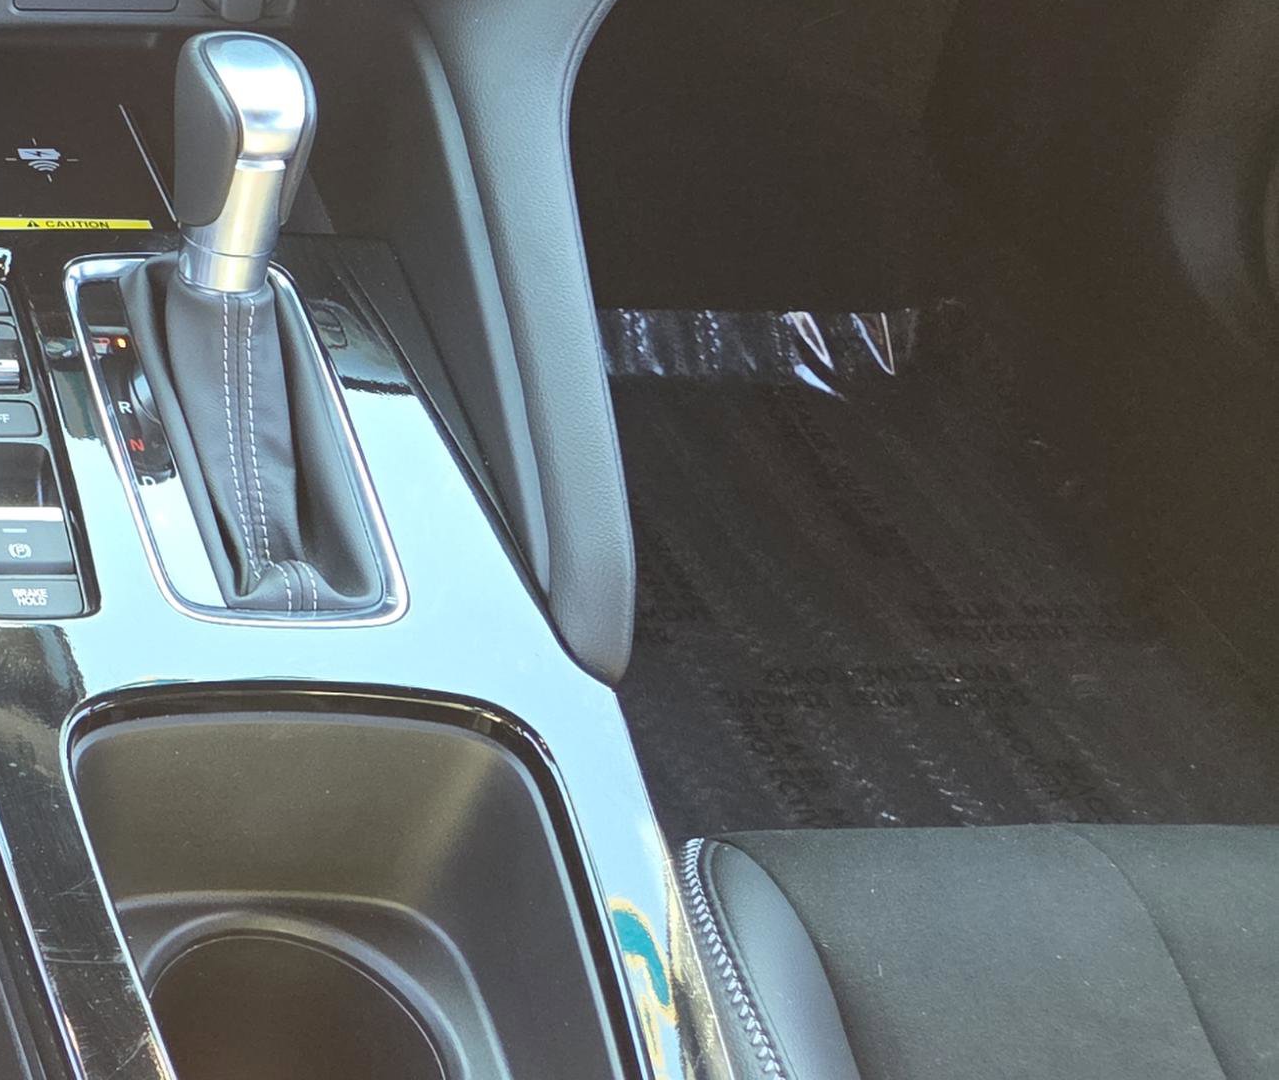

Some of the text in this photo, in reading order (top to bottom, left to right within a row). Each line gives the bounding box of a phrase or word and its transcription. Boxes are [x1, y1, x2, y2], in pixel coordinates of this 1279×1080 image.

[45, 220, 110, 230] CAUTION
[118, 401, 133, 413] R
[130, 439, 145, 452] N
[12, 588, 48, 598] BRAKE
[17, 596, 47, 607] HOLD
